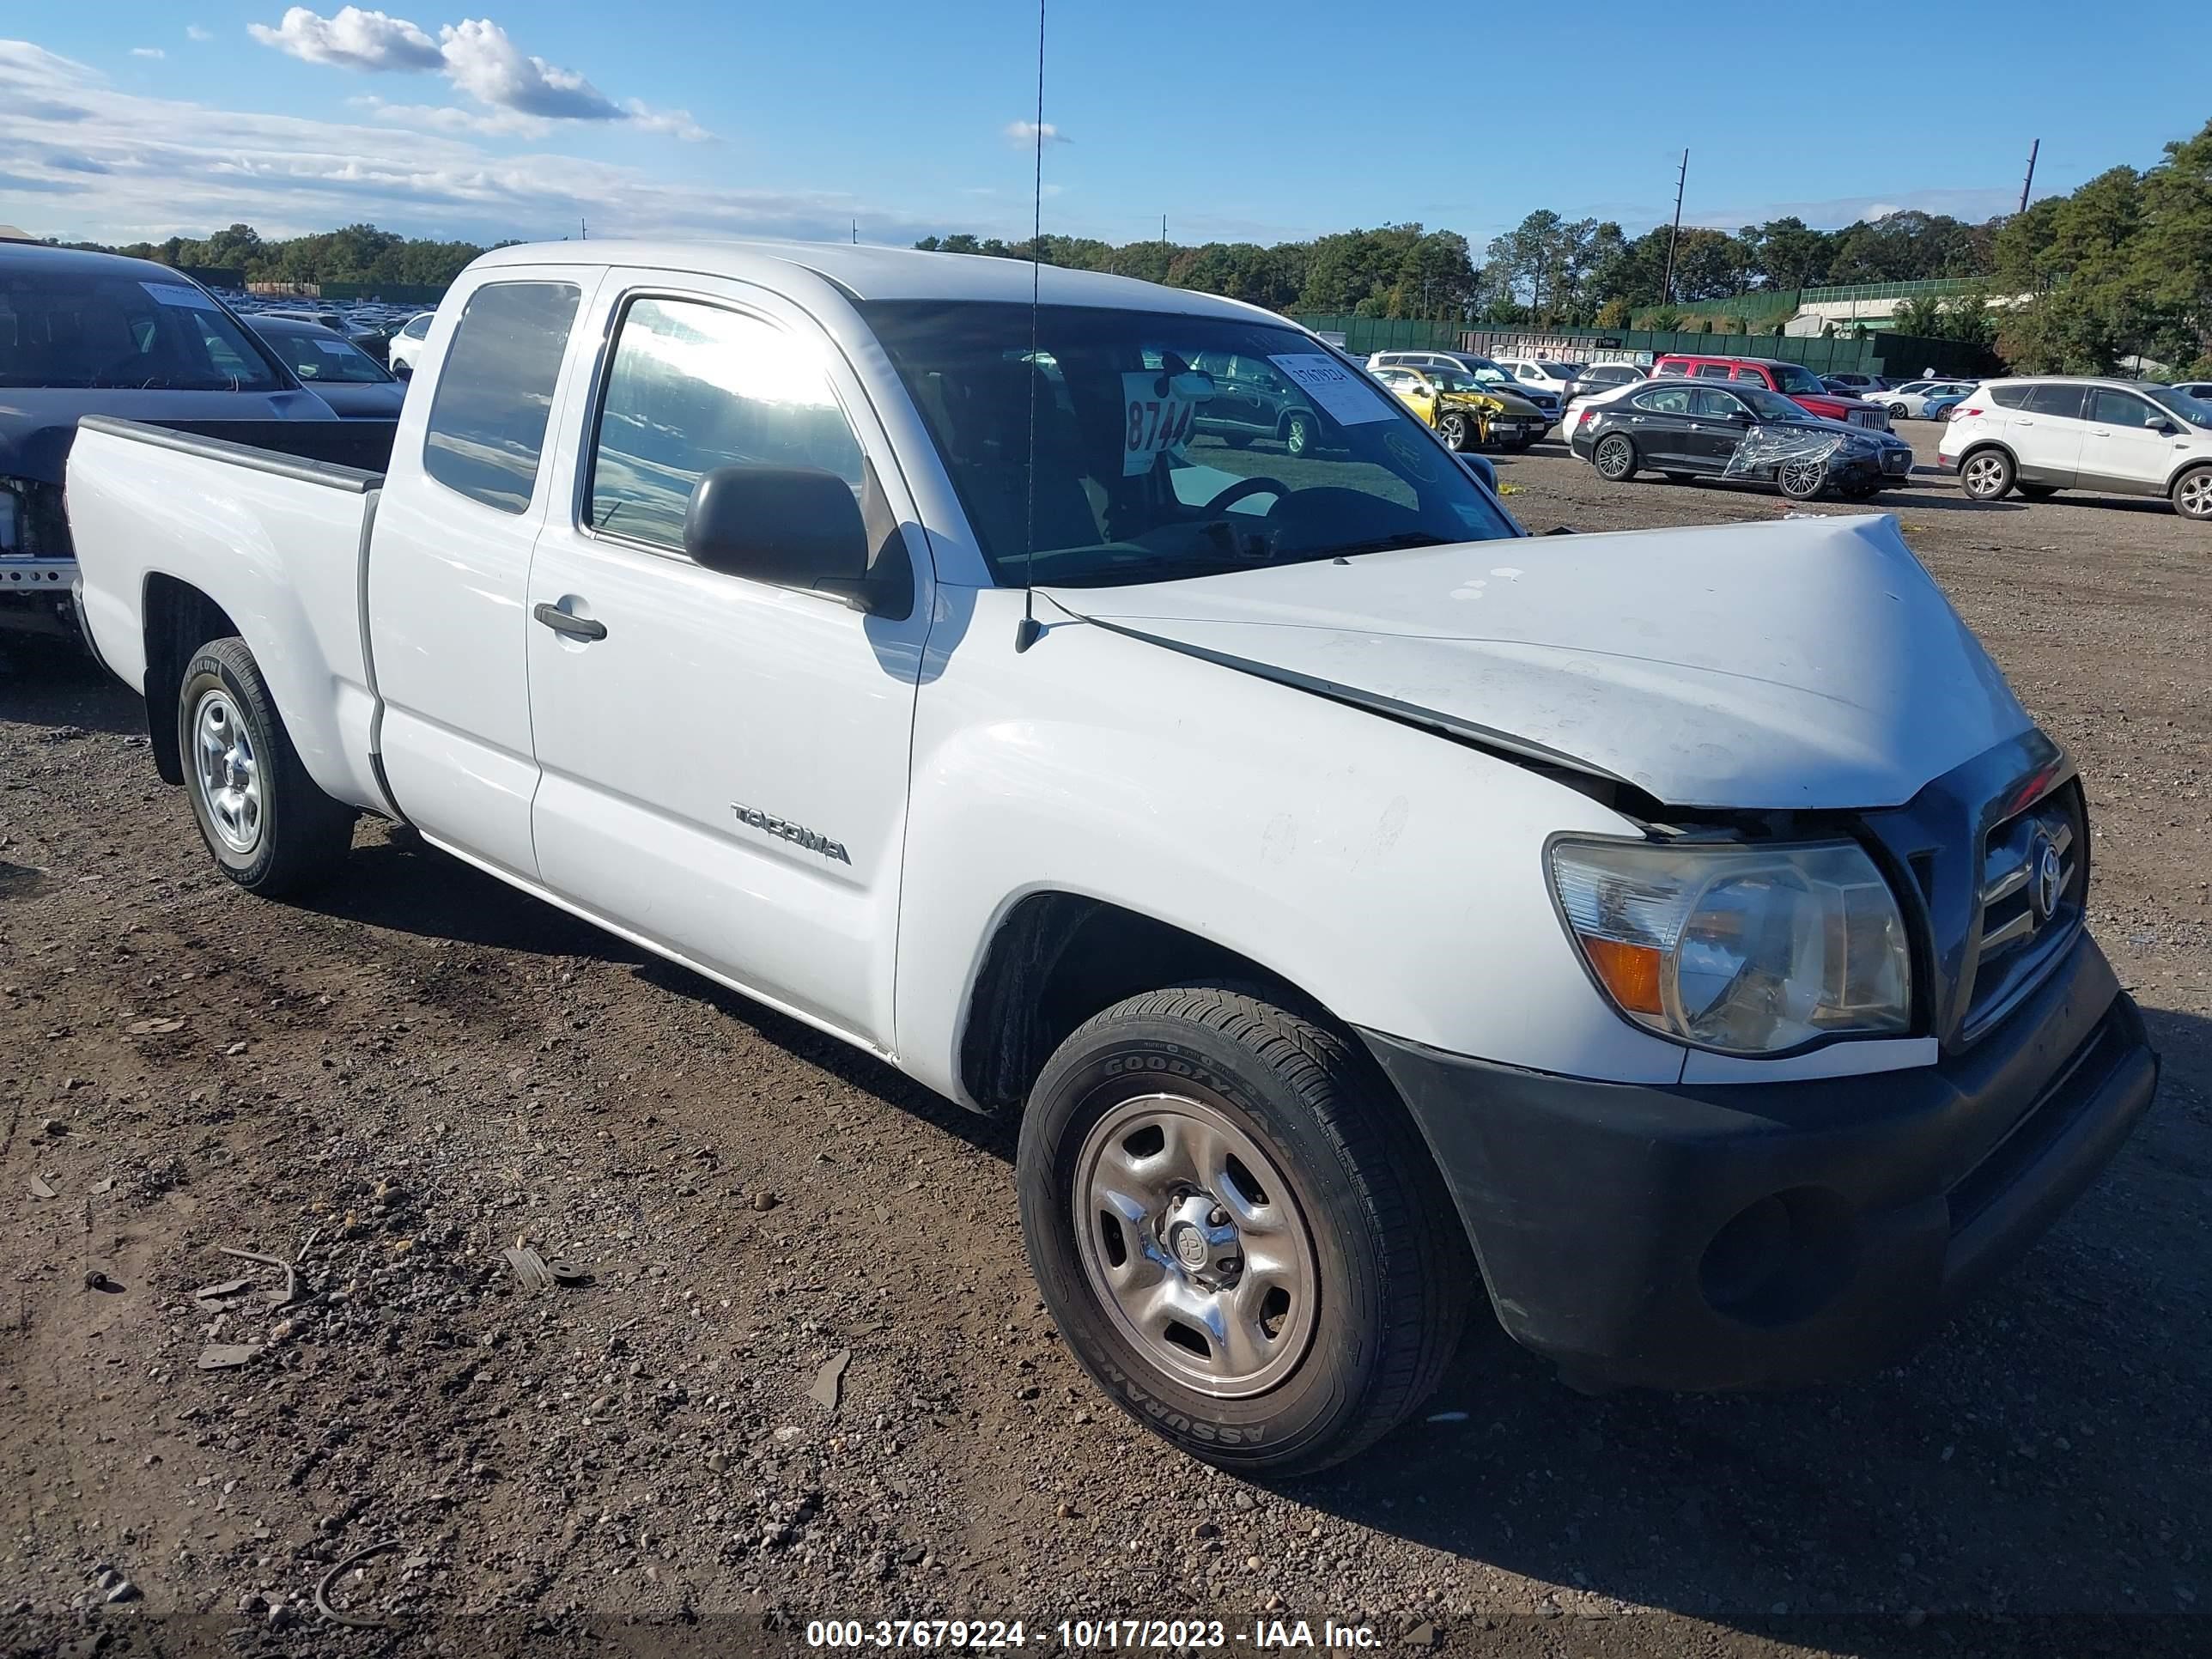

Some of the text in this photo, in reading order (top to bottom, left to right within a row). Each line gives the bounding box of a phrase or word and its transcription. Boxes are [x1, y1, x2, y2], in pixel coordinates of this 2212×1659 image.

[1291, 368, 1348, 384] 37679224
[1127, 400, 1192, 452] 8744
[729, 800, 853, 866] TACOMA
[1104, 1055, 1294, 1160] GOODYEAR
